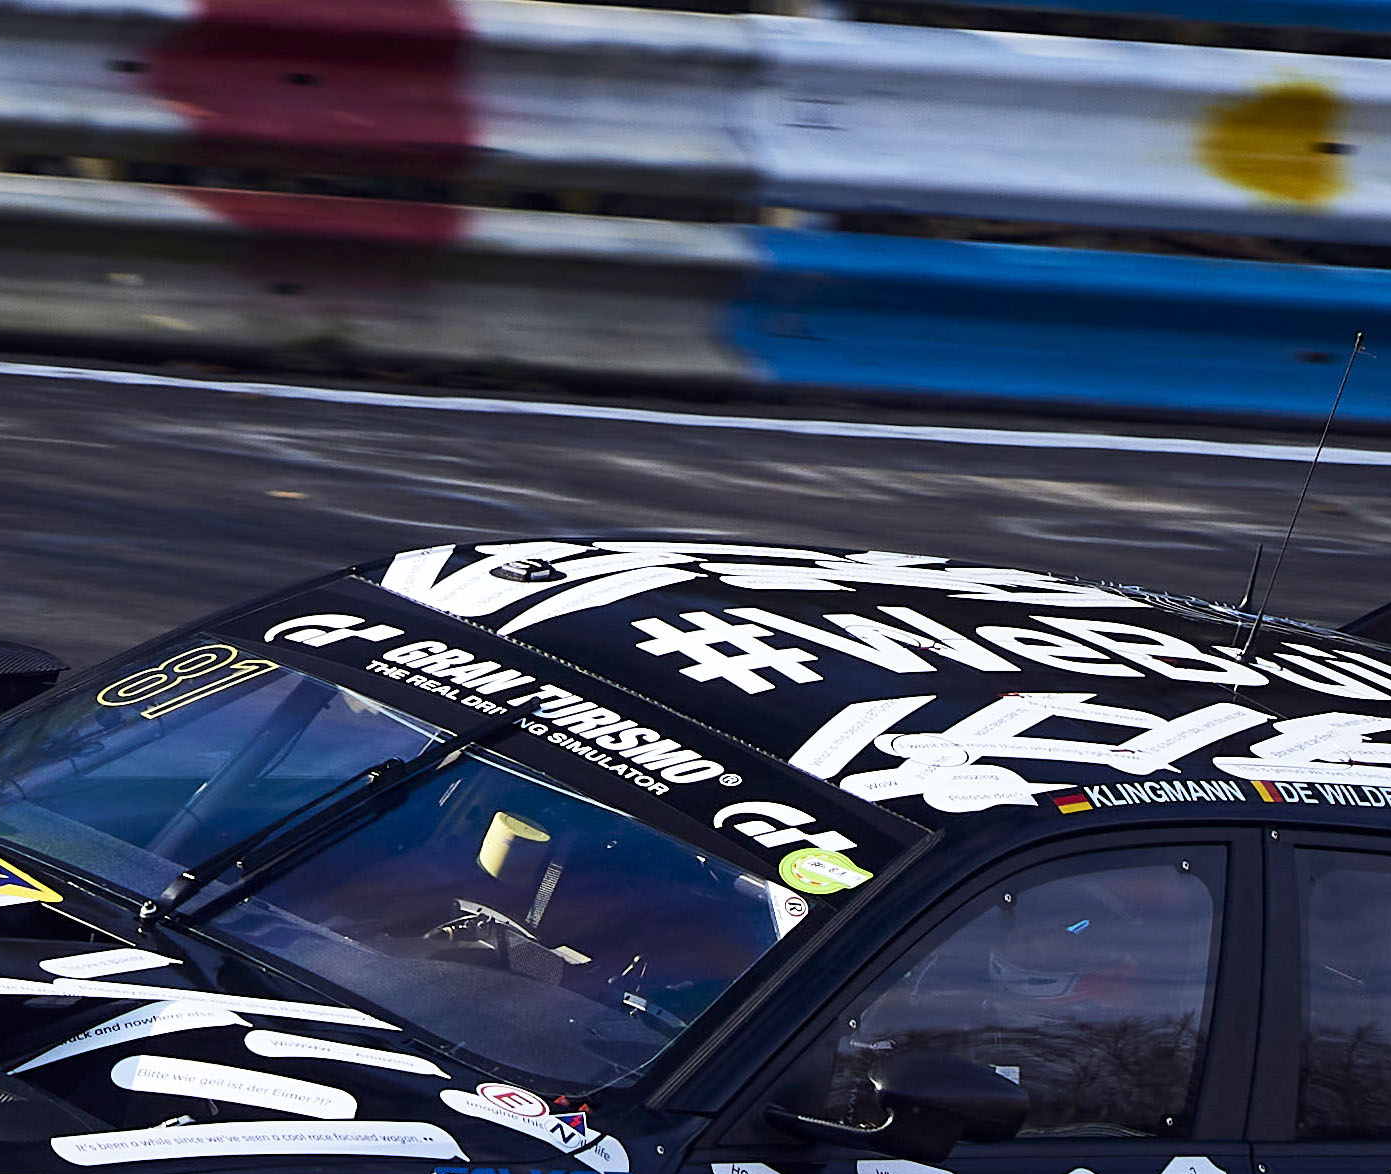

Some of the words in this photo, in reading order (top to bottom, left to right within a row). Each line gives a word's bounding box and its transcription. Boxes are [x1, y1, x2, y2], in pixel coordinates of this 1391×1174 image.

[97, 643, 280, 720] 81
[382, 640, 533, 696] GRAN
[365, 659, 406, 681] THE
[406, 673, 462, 701] REAL
[546, 729, 671, 796] SIMULATOR
[1084, 780, 1246, 809] KLINGMANN
[1275, 782, 1319, 804] DE
[94, 1021, 121, 1037] and
[123, 1011, 183, 1029] nowhere
[136, 1066, 170, 1081] Bitte
[172, 1072, 197, 1084] wie
[199, 1076, 226, 1090] geil
[226, 1080, 245, 1091] ist
[245, 1082, 271, 1094] der
[97, 1139, 129, 1152] been
[140, 1135, 173, 1149] while
[173, 1133, 204, 1146] since
[205, 1132, 239, 1145] we've
[240, 1133, 271, 1143] seen
[281, 1131, 307, 1142] cool
[308, 1132, 332, 1142] race
[332, 1131, 379, 1143] focused
[549, 1123, 576, 1145] N
